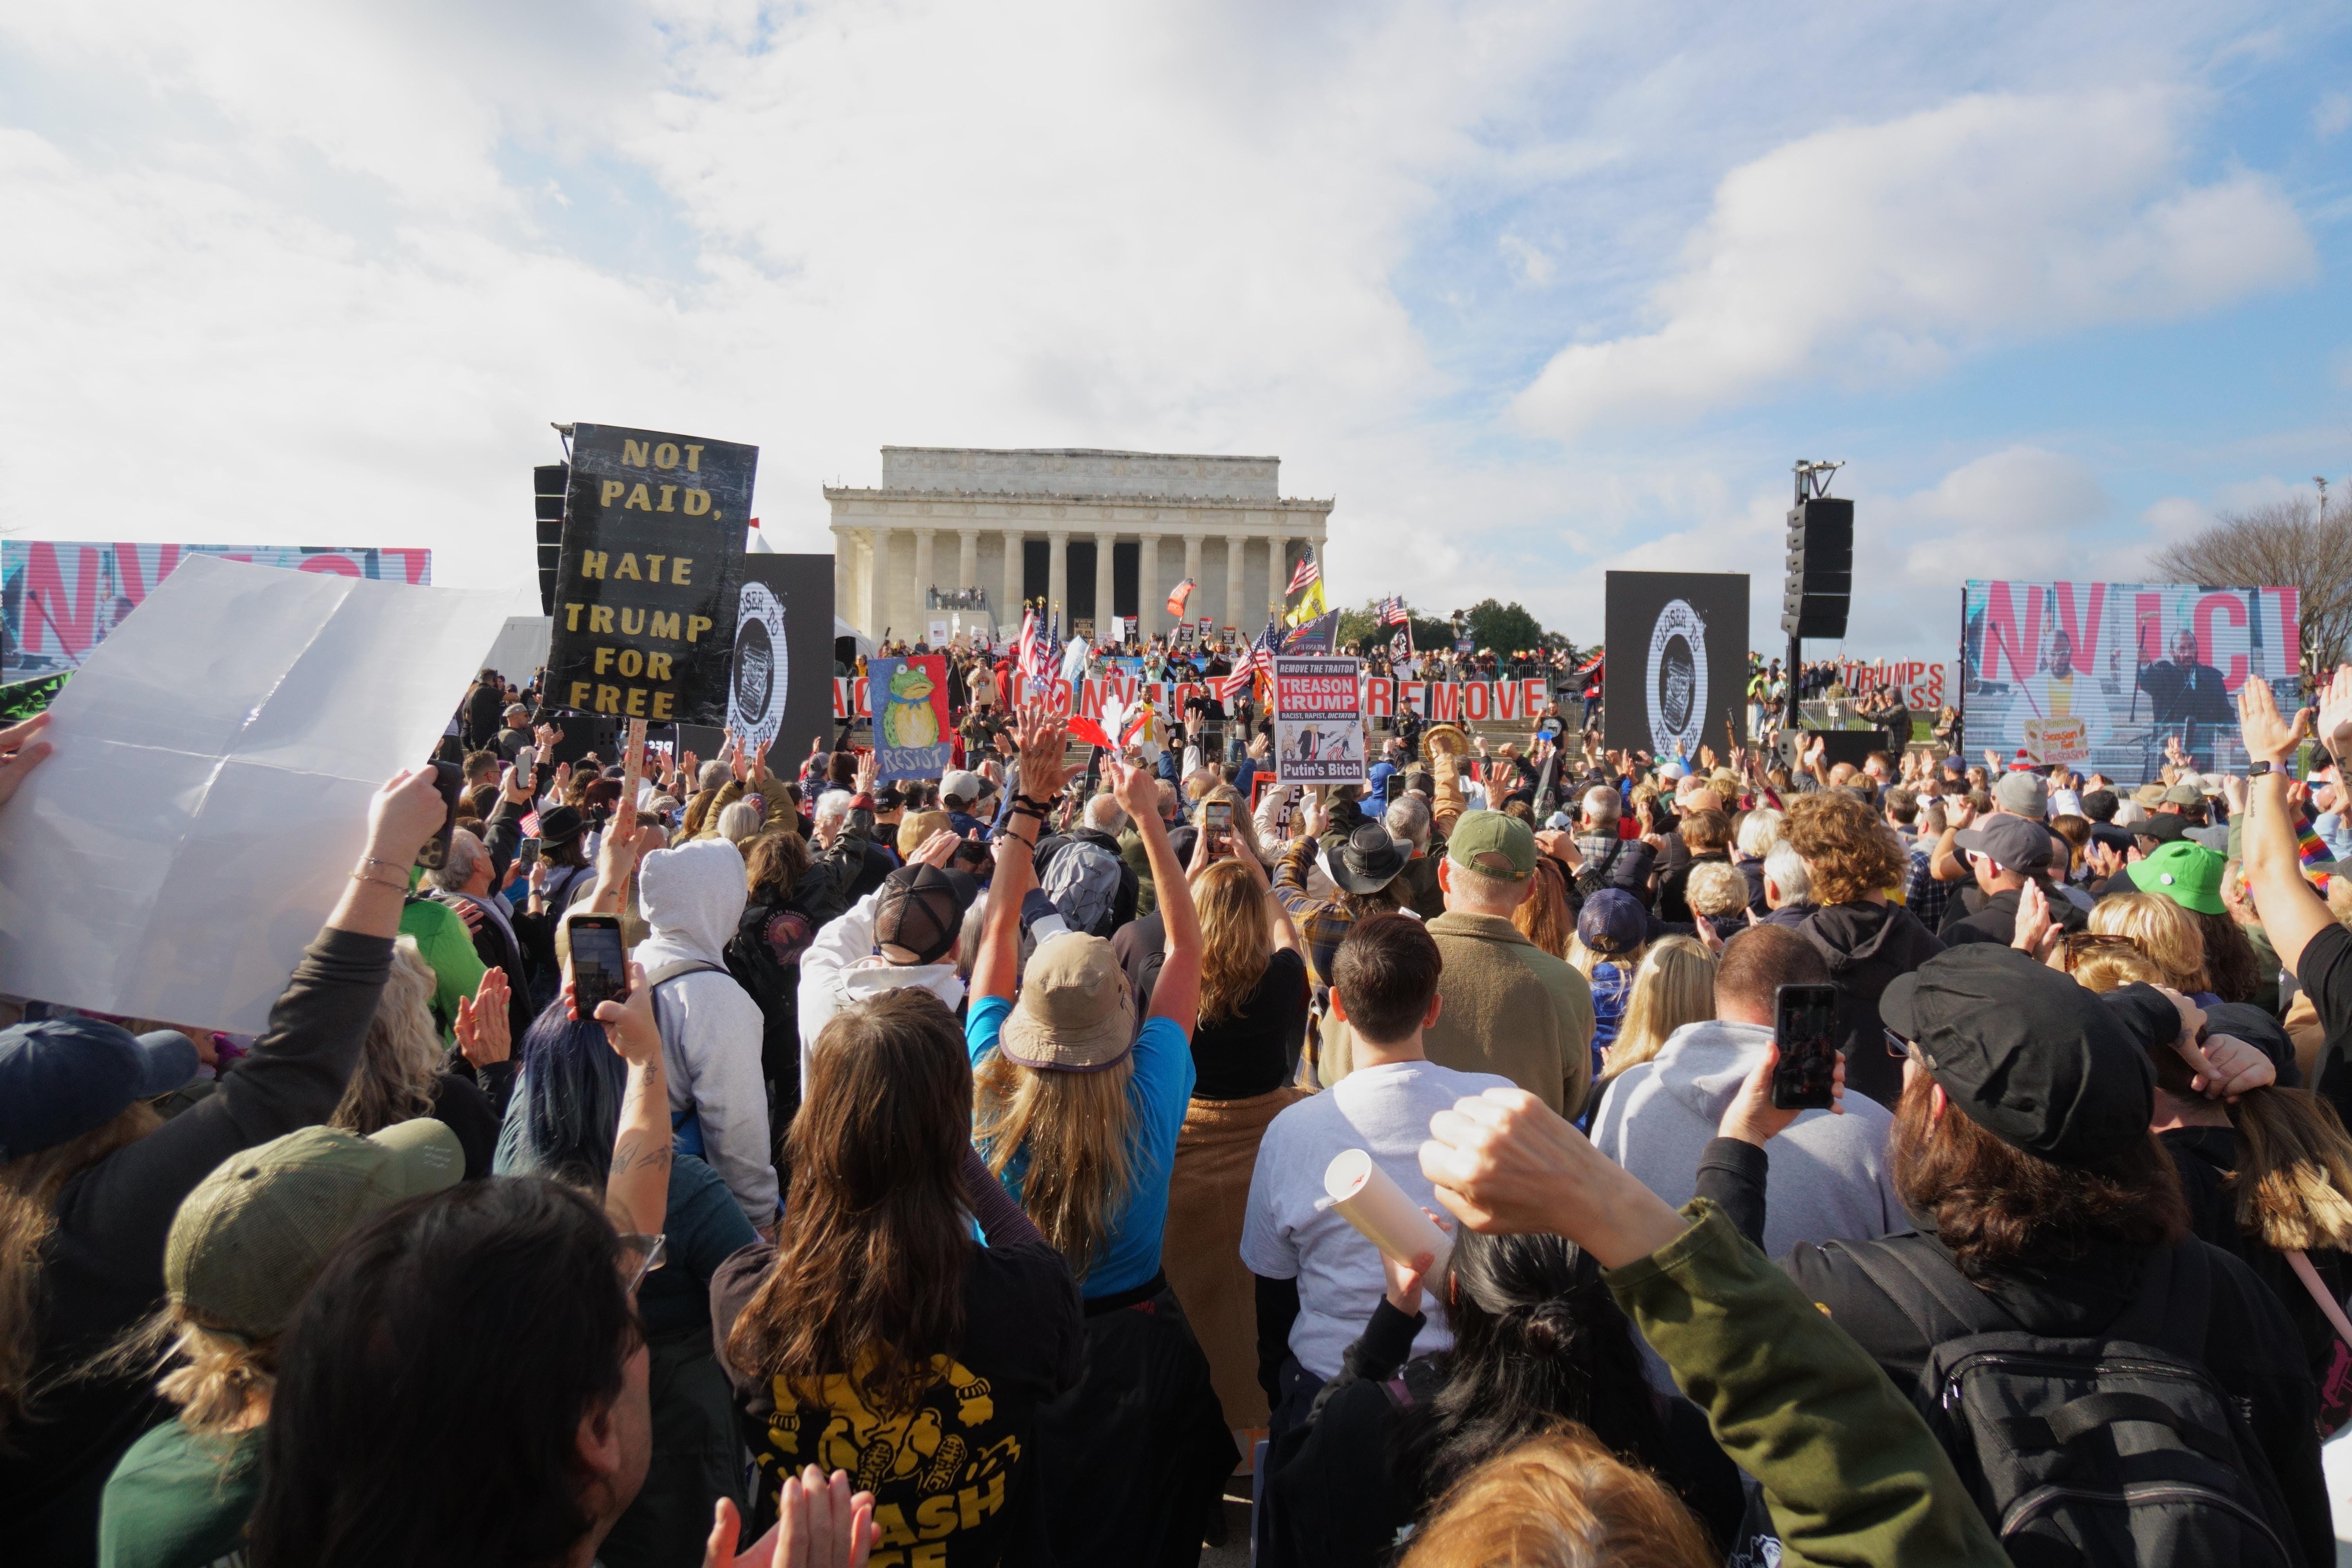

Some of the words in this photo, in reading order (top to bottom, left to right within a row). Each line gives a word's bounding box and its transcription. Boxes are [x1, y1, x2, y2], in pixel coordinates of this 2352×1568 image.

[622, 439, 704, 472] NOT
[601, 481, 722, 521] PAID,
[581, 550, 693, 585] HATE
[565, 603, 713, 642] TRUMP
[1656, 609, 1686, 652] CLOSER
[1690, 623, 1700, 652] TO
[594, 647, 673, 681] FOR
[1279, 664, 1308, 673] REMOVE
[1310, 665, 1323, 673] THE
[1325, 665, 1354, 673] TRAITOR
[569, 682, 675, 720] FREE
[1280, 679, 1352, 693] TREASON
[1283, 695, 1355, 710] tRUMP
[1367, 678, 1546, 720] REMOVE
[753, 710, 777, 751] EDGE
[1656, 720, 1671, 757] THE
[1284, 764, 1325, 776] Putin's
[1329, 764, 1360, 776] Bitch
